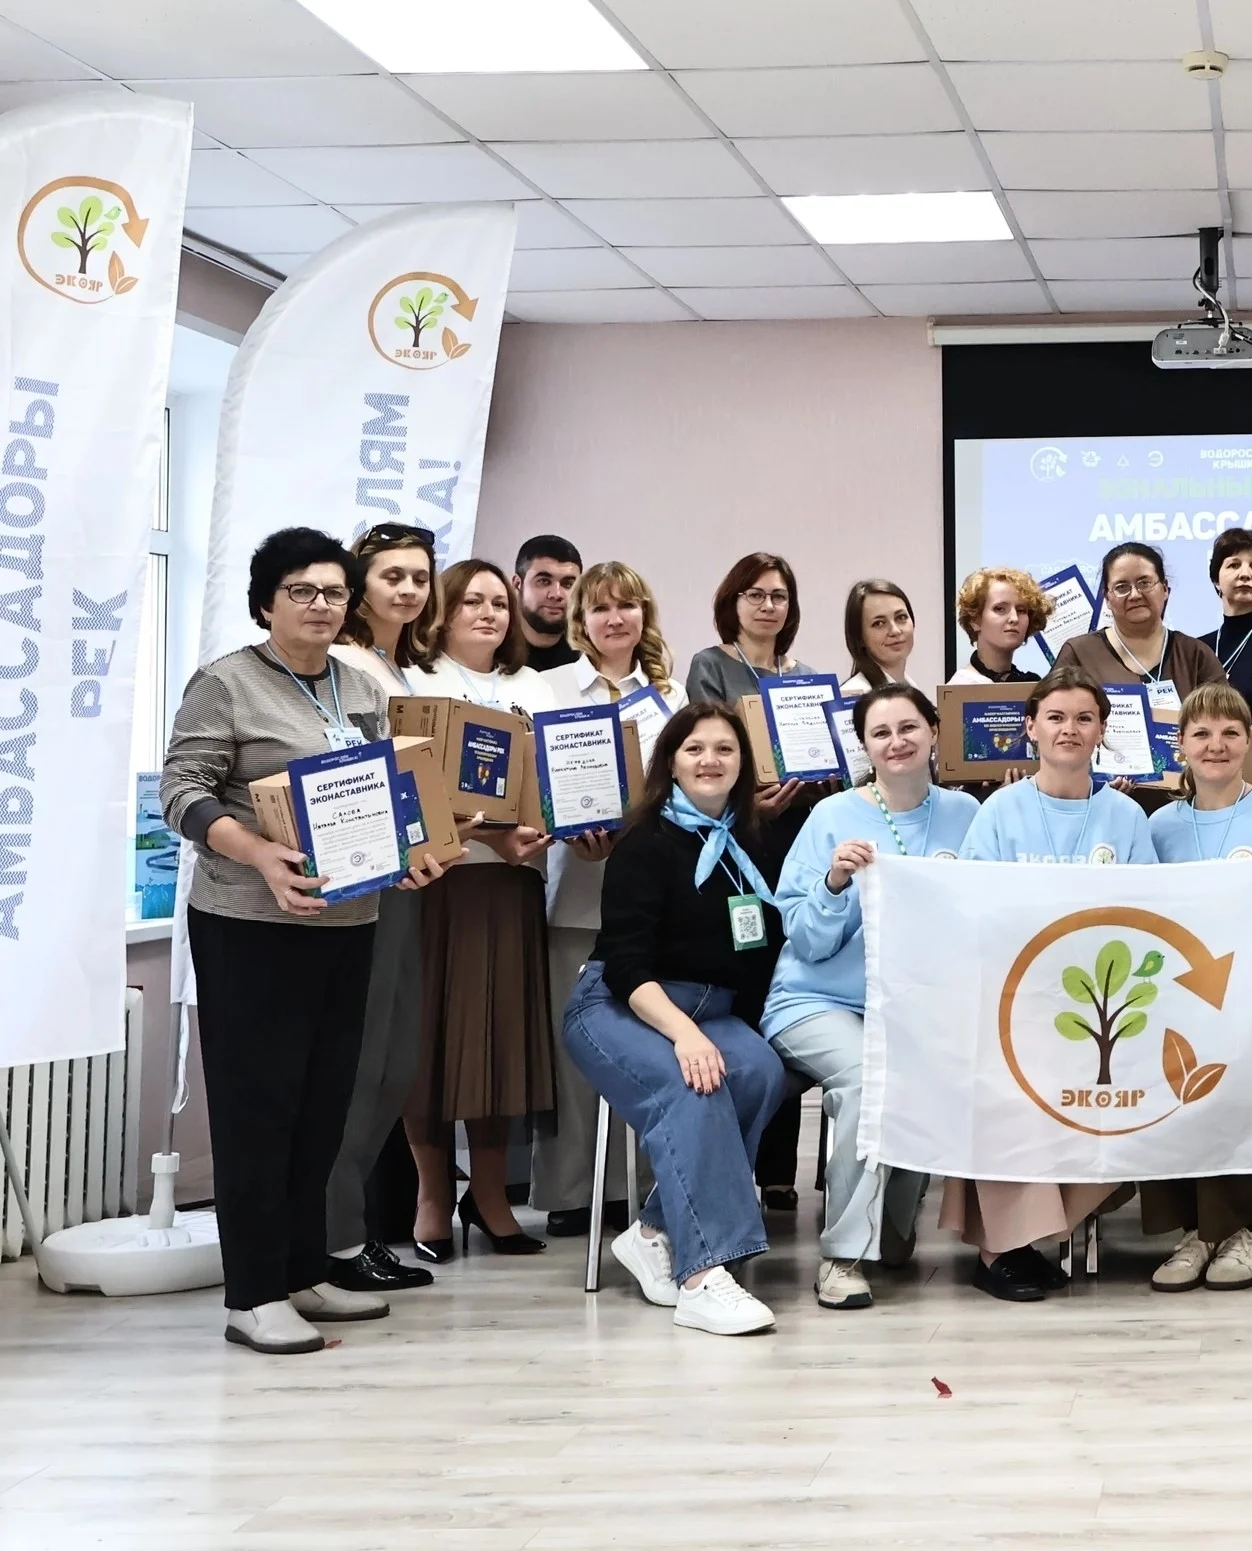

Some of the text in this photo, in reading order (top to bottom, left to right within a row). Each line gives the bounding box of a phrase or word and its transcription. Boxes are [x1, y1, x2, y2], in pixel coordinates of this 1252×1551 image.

[55, 273, 103, 292] ЭКОЯР
[394, 349, 437, 360] ЭКОЯР
[780, 694, 824, 702] СЕРТИФИКАТ
[555, 730, 603, 741] СЕРТИФИКАТ
[550, 738, 611, 751] ЭКОНАСТАВНИКА
[316, 772, 375, 793] СЕРТИФИКАТ
[310, 781, 385, 805] ЭКОНАСТАВНИКА
[1061, 1089, 1145, 1108] ЭКОЯР
